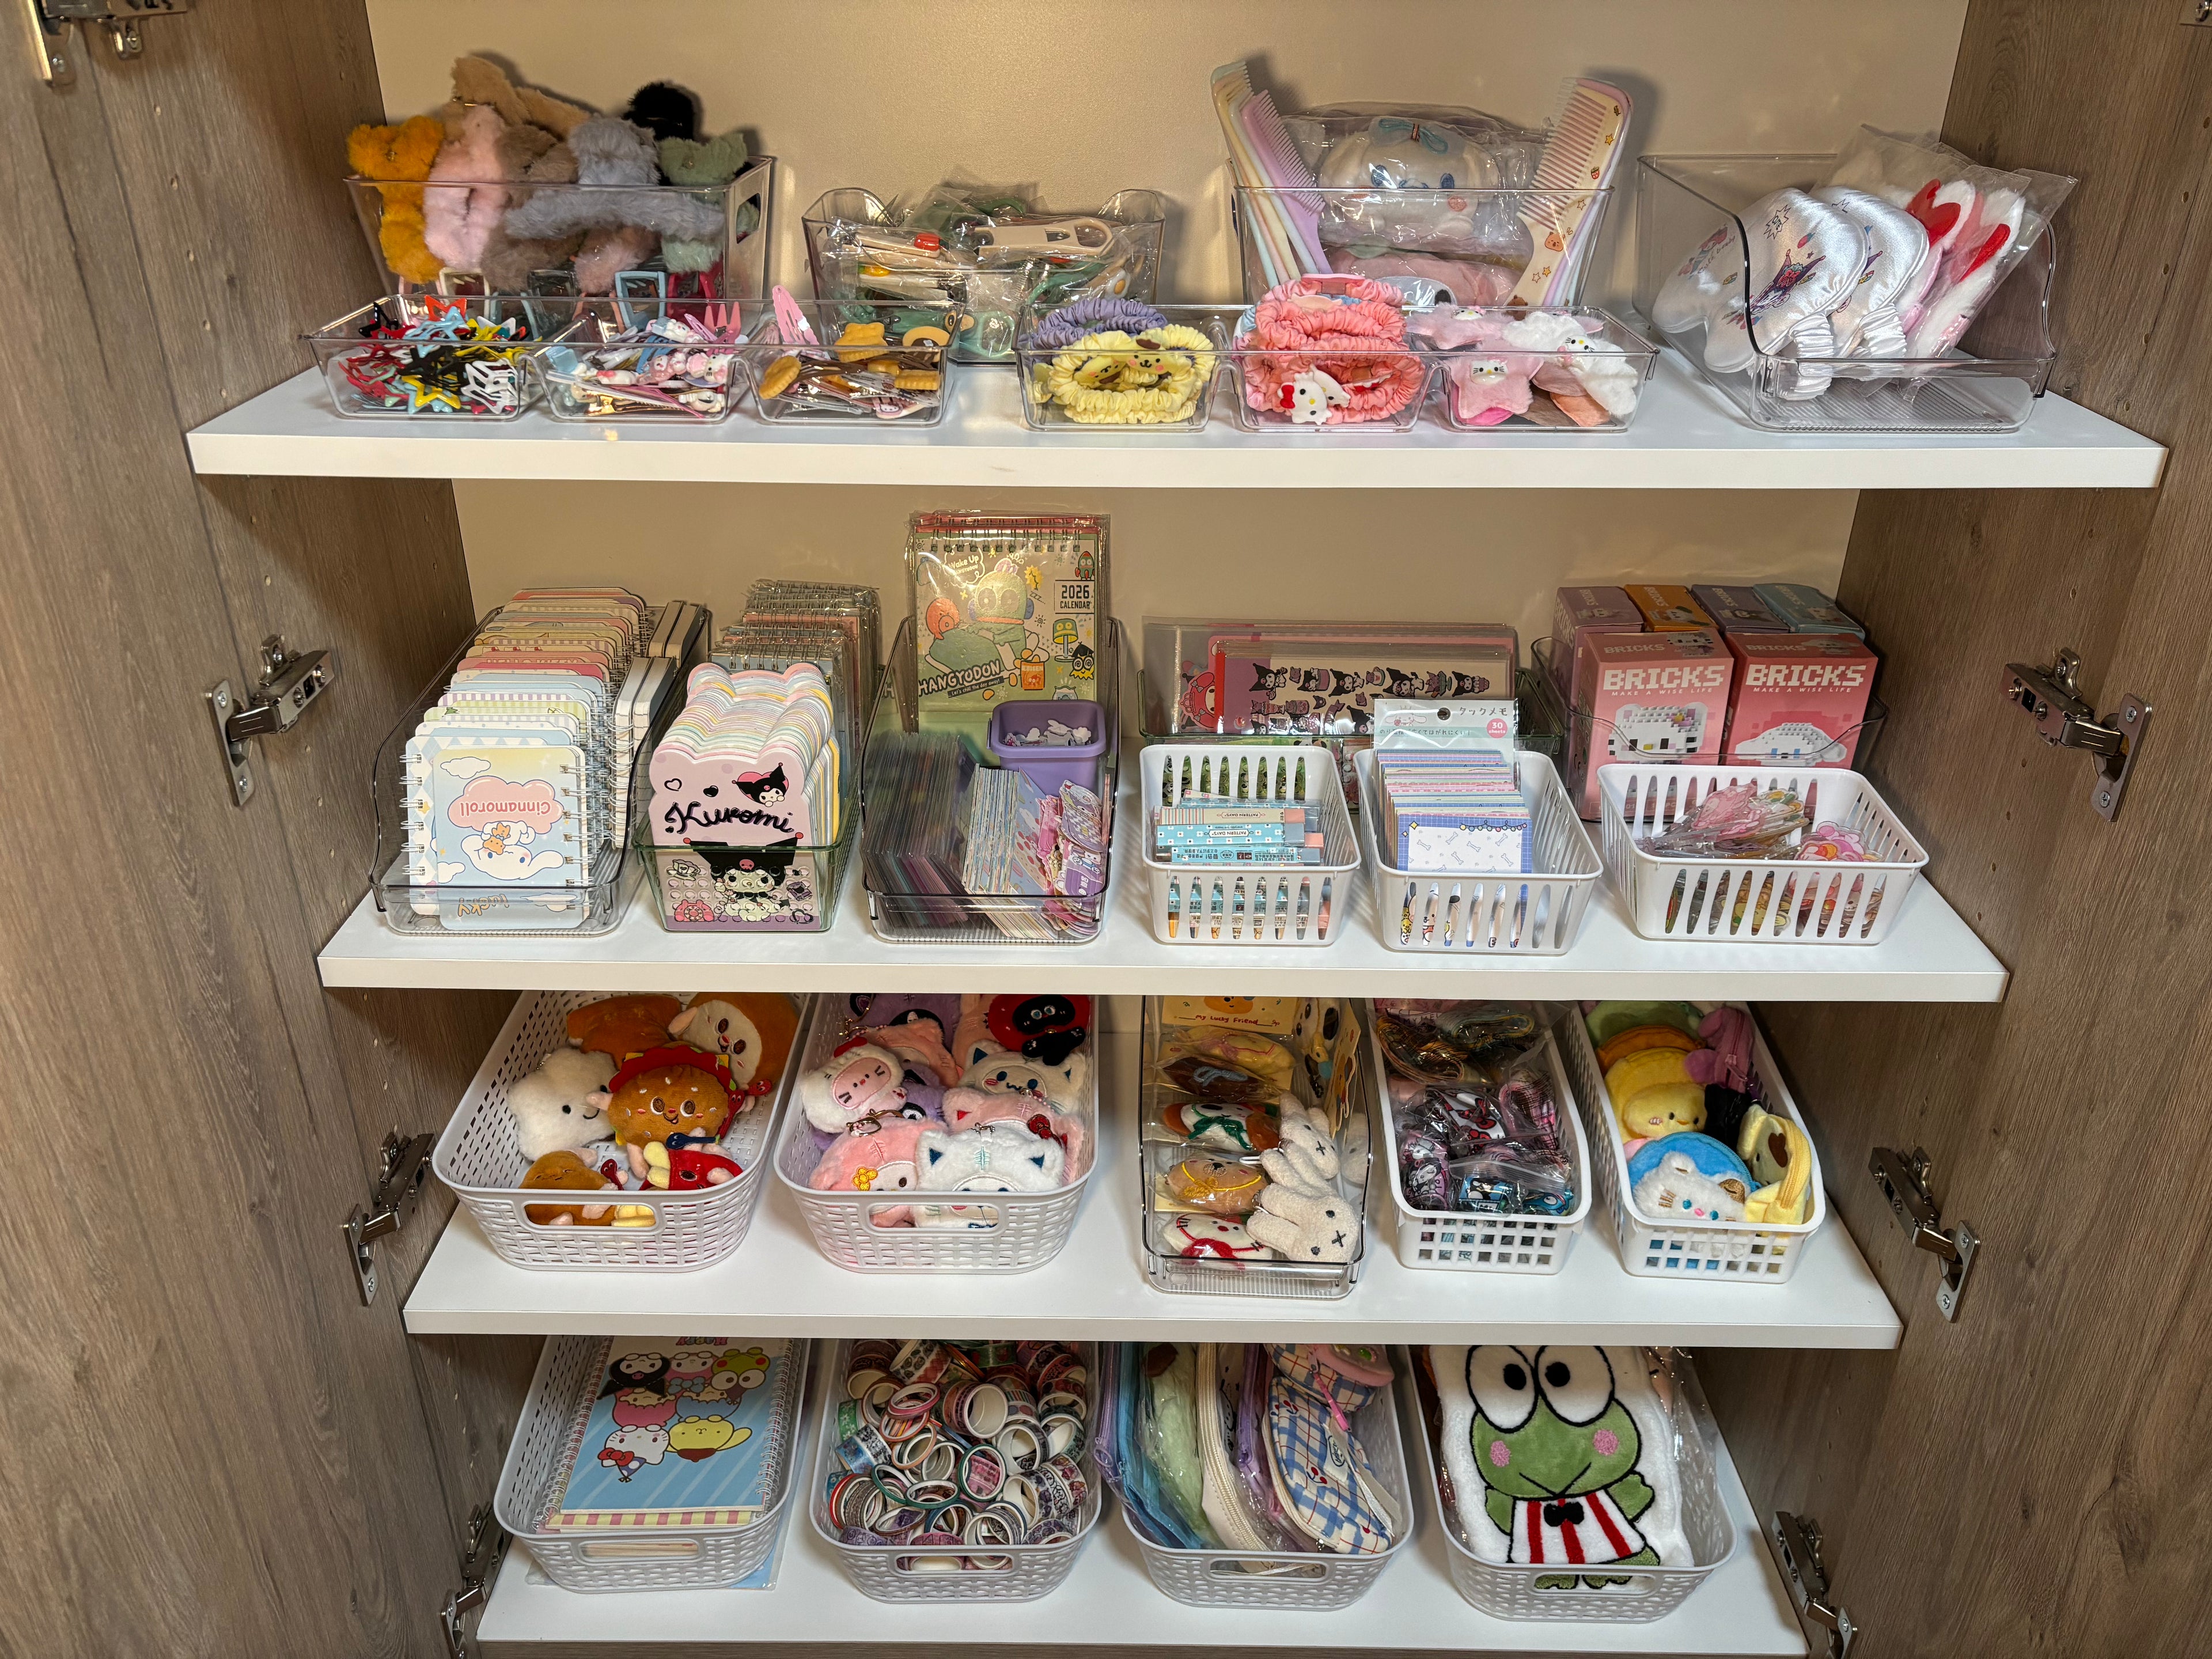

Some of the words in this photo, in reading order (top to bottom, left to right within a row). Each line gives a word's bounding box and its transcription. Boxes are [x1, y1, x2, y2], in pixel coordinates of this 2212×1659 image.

[968, 555, 979, 563] Up
[953, 564, 978, 574] ANGYODON
[1062, 585, 1089, 599] 2026
[1643, 586, 1669, 607] BRICKS
[1060, 601, 1090, 609] CALENDAR
[1604, 644, 1665, 653] BRICKS
[918, 660, 1001, 696] HANGYODON
[1603, 665, 1725, 690] BRICKS
[1745, 664, 1866, 687] BRICKS
[1459, 707, 1508, 716] タックメモ
[460, 801, 551, 816] Cinnamoroll
[664, 801, 795, 834] Kuromi
[457, 893, 509, 918] lucky
